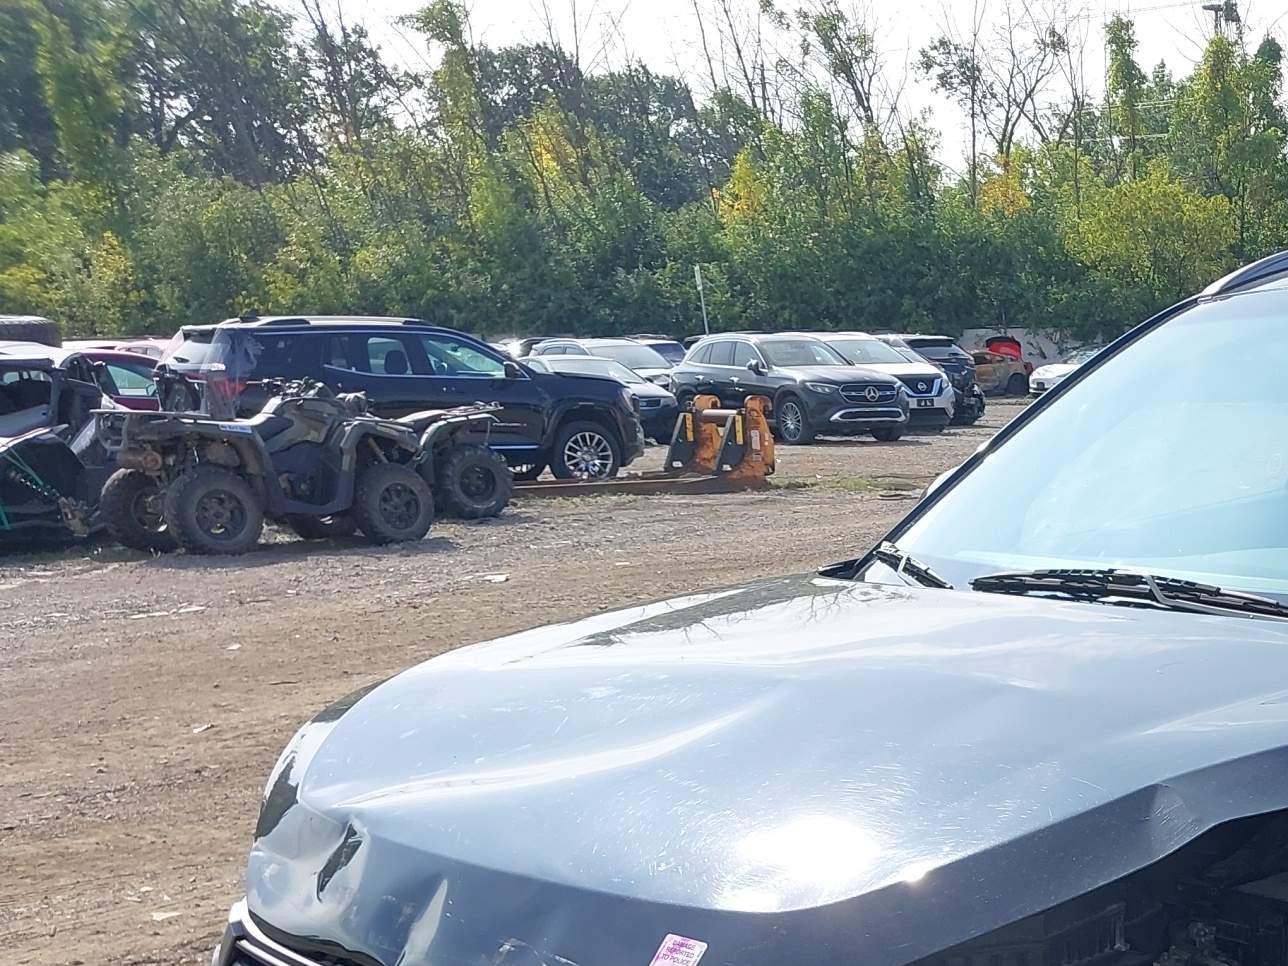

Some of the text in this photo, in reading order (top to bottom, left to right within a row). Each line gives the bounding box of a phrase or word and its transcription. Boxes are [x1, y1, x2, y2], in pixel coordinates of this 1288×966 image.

[672, 940, 696, 951] DAMAGE
[666, 946, 695, 959] REPORTED
[661, 953, 691, 966] TO POLICE
